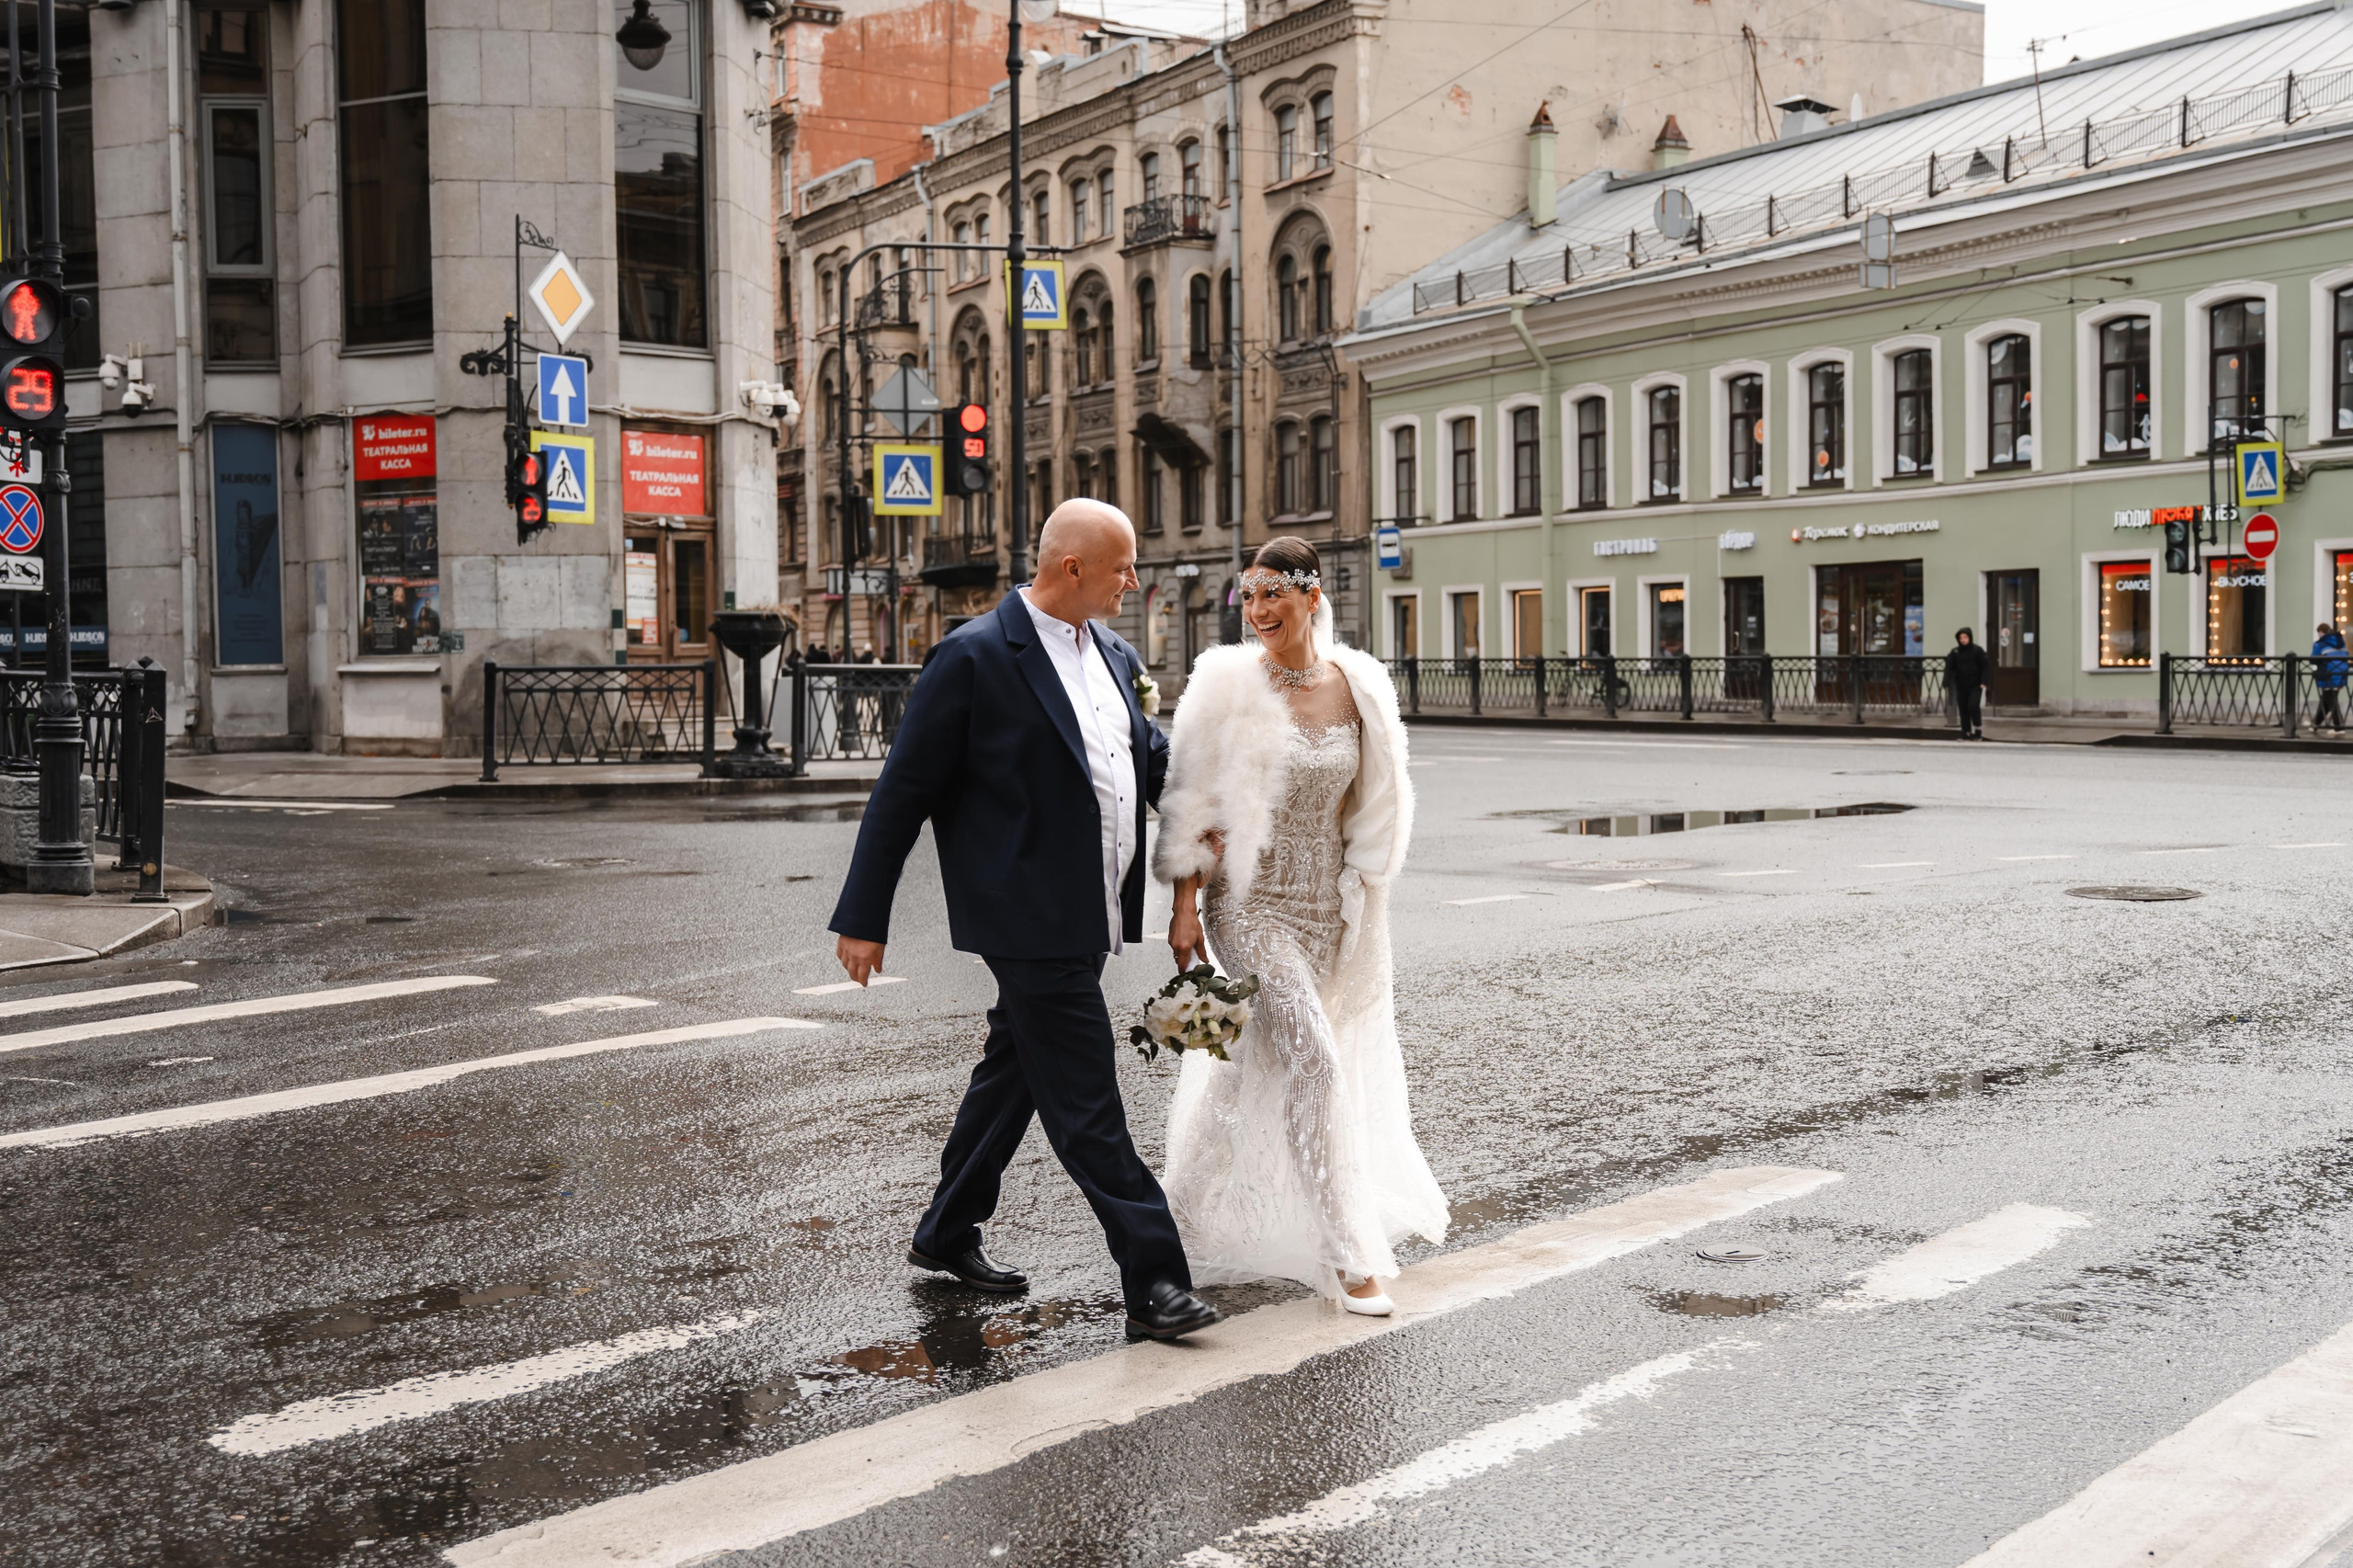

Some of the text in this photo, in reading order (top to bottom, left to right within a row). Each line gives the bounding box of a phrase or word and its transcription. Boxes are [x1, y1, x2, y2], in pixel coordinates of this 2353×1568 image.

[9, 368, 53, 411] 29
[378, 427, 427, 439] bileter.ru
[363, 443, 428, 457] ТЕАТРАЛЬНАЯ
[645, 446, 698, 460] bileter.ru
[381, 459, 412, 470] КАССА
[629, 471, 699, 484] ТЕАТРАЛЬНАЯ
[648, 485, 682, 496] КАССА
[2114, 509, 2152, 528] ЛЮДИ
[1867, 520, 1940, 535] КОНДИТЕРСКАЯ
[2116, 580, 2151, 591] САМОЕ
